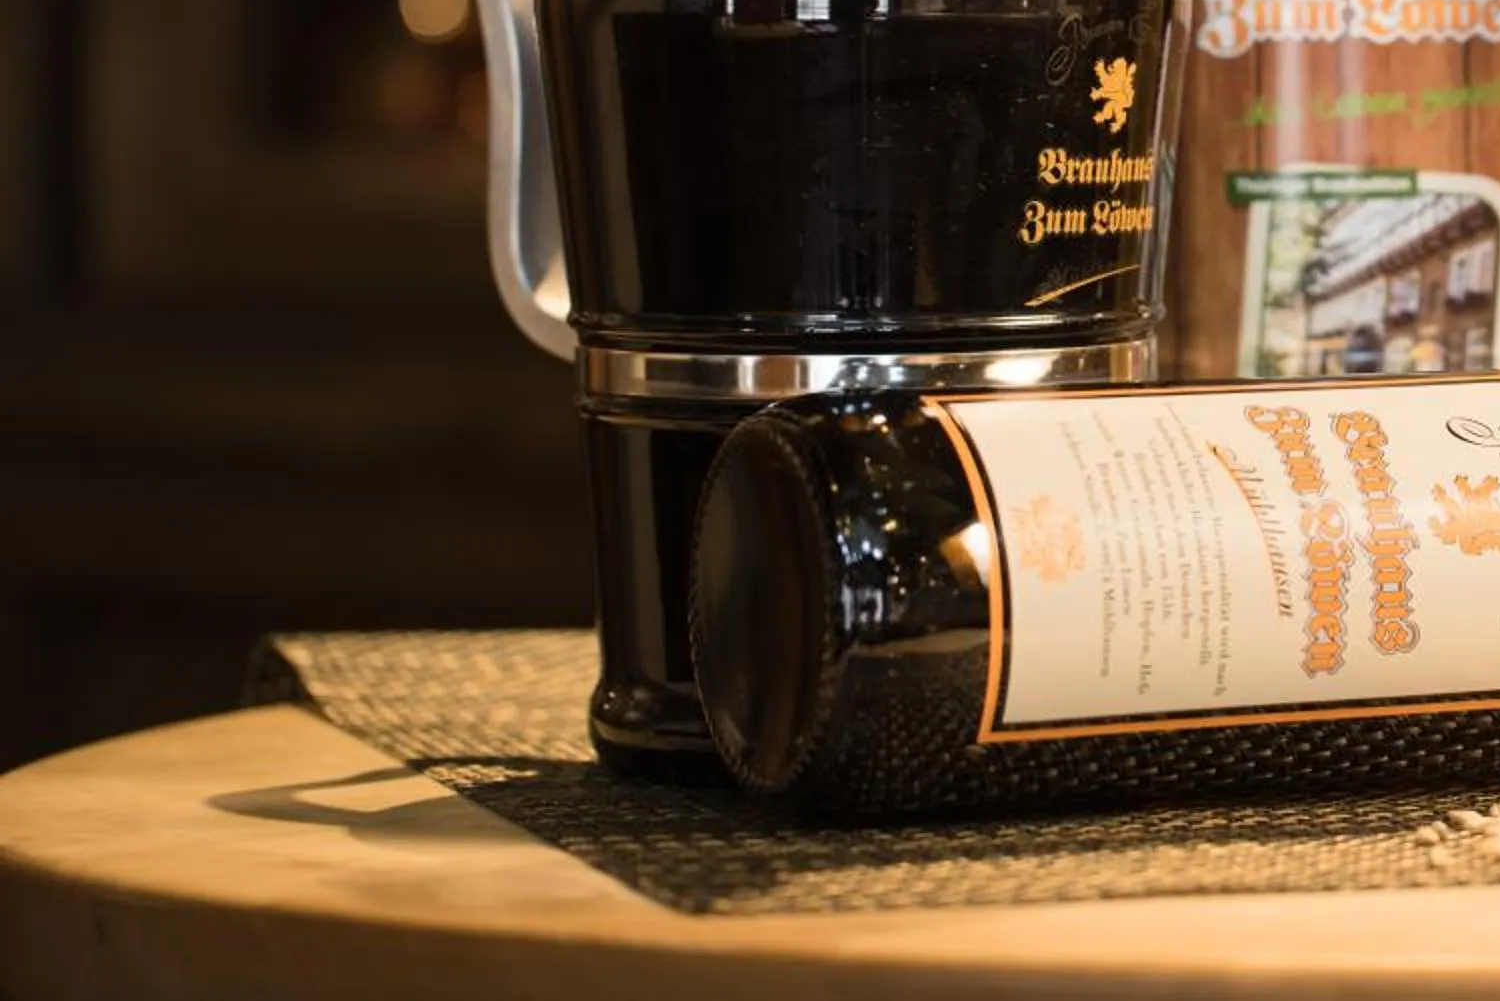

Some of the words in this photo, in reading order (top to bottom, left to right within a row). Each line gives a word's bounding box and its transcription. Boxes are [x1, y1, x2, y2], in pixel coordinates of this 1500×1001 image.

[1018, 199, 1086, 245] Zum
[1092, 199, 1154, 235] Löwen
[1037, 148, 1154, 193] Brauhaus
[1223, 447, 1295, 618] Mühlhausen
[1243, 405, 1328, 497] Zum
[1299, 498, 1355, 679] Löwen
[1328, 410, 1420, 655] Brauhaus
